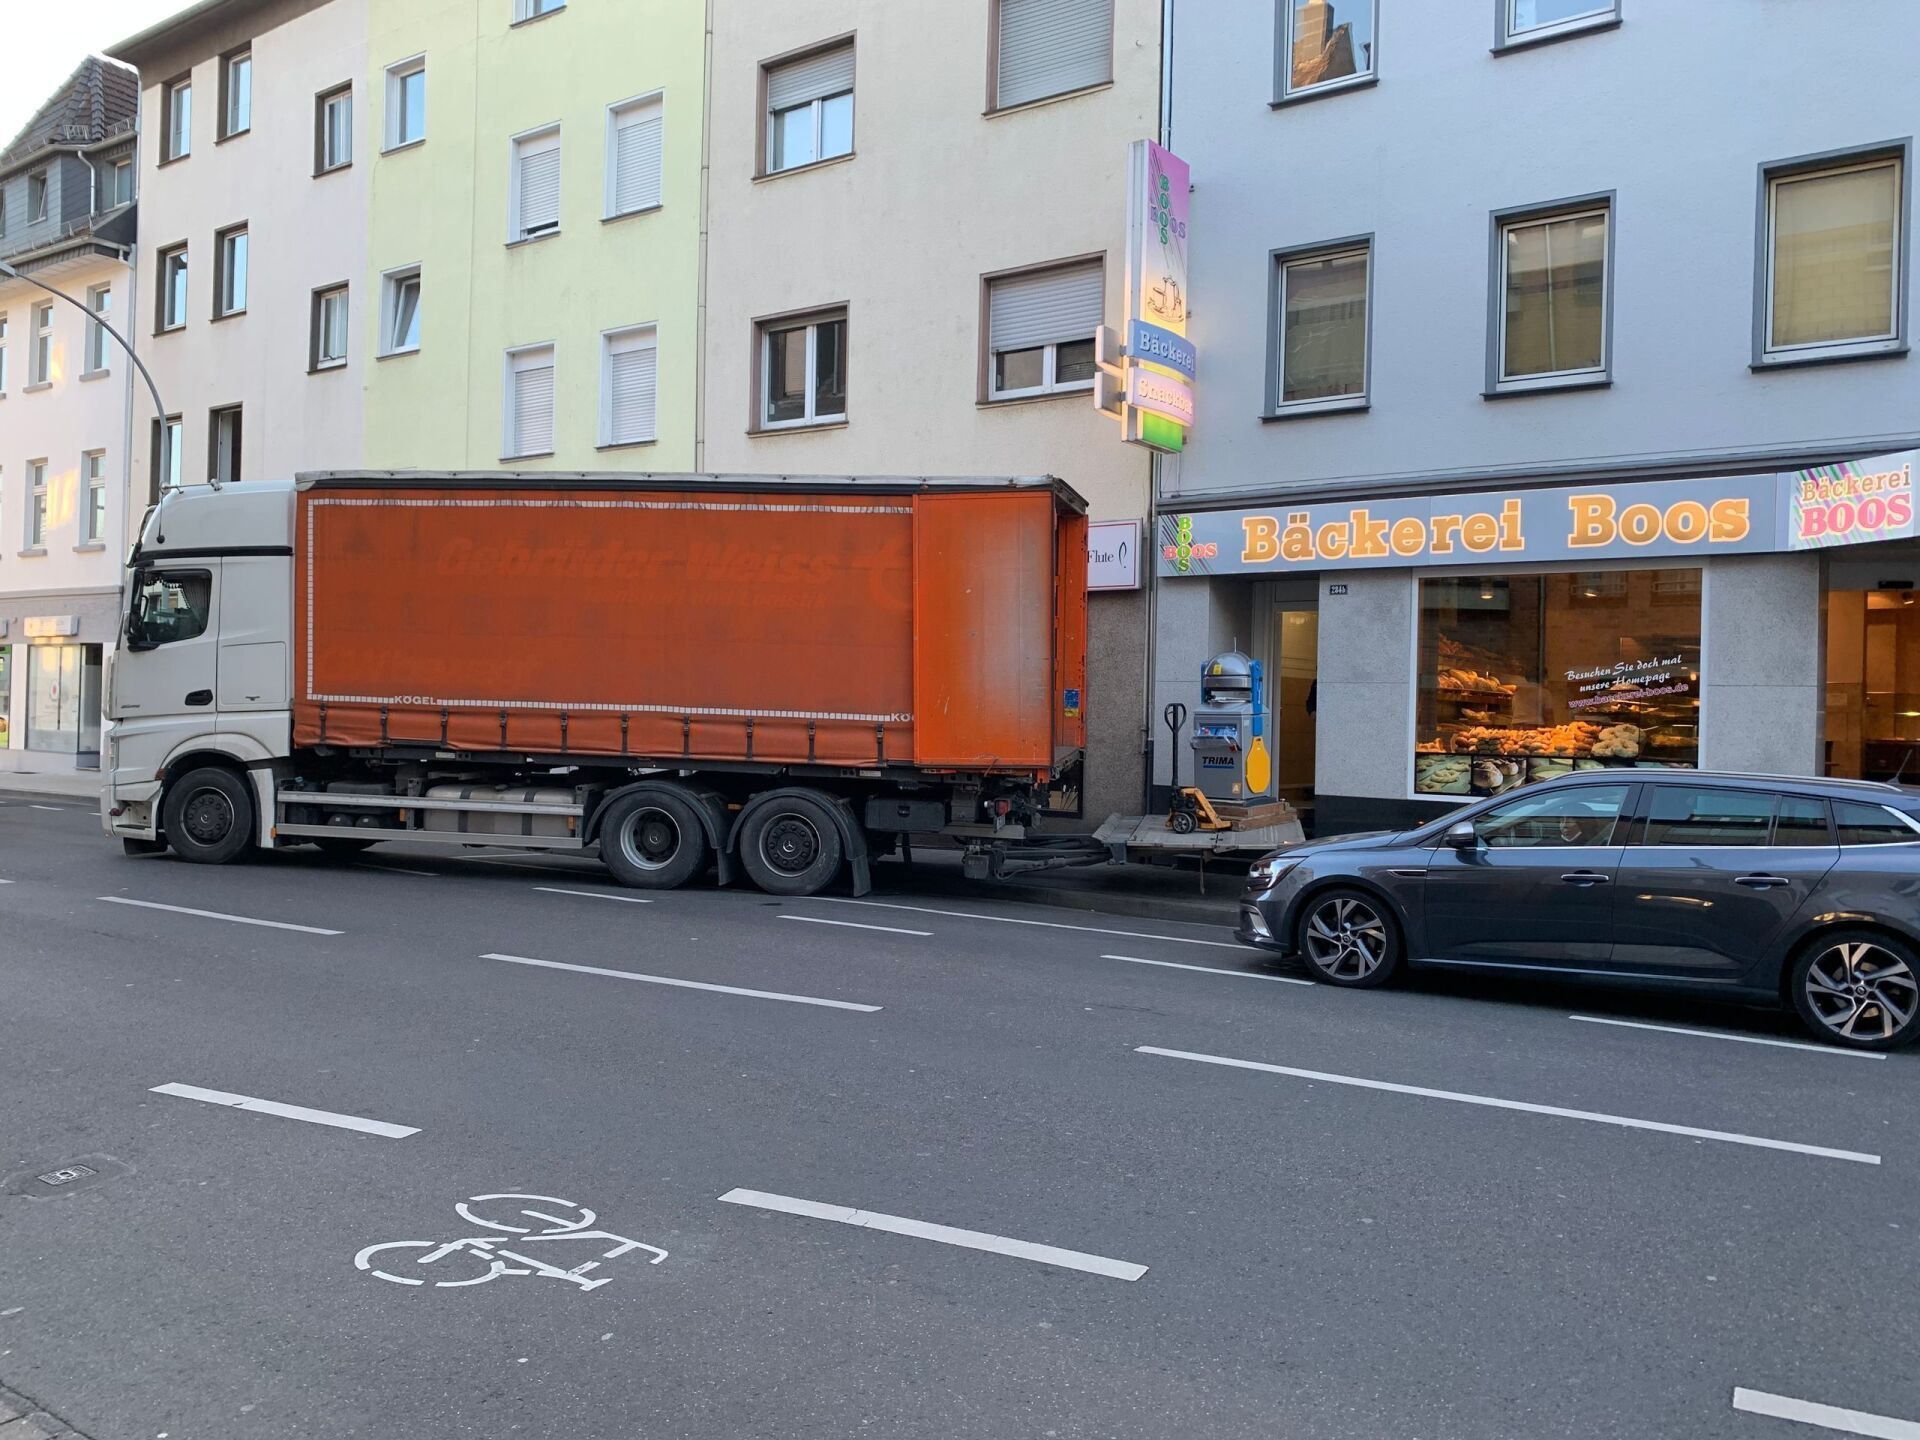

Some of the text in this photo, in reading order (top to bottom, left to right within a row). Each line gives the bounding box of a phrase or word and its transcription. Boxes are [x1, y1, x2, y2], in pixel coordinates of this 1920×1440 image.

[1140, 329, 1195, 372] Bäckerei
[1803, 464, 1910, 501] Bäckerei
[1241, 498, 1526, 564] Bäckerei
[1800, 493, 1913, 538] BOOS
[1564, 654, 1682, 681] Besuchen Sie doch mal
[1579, 672, 1670, 692] unsere Homepage
[394, 694, 436, 705] KÖGEL
[1202, 756, 1235, 765] TRIMA
